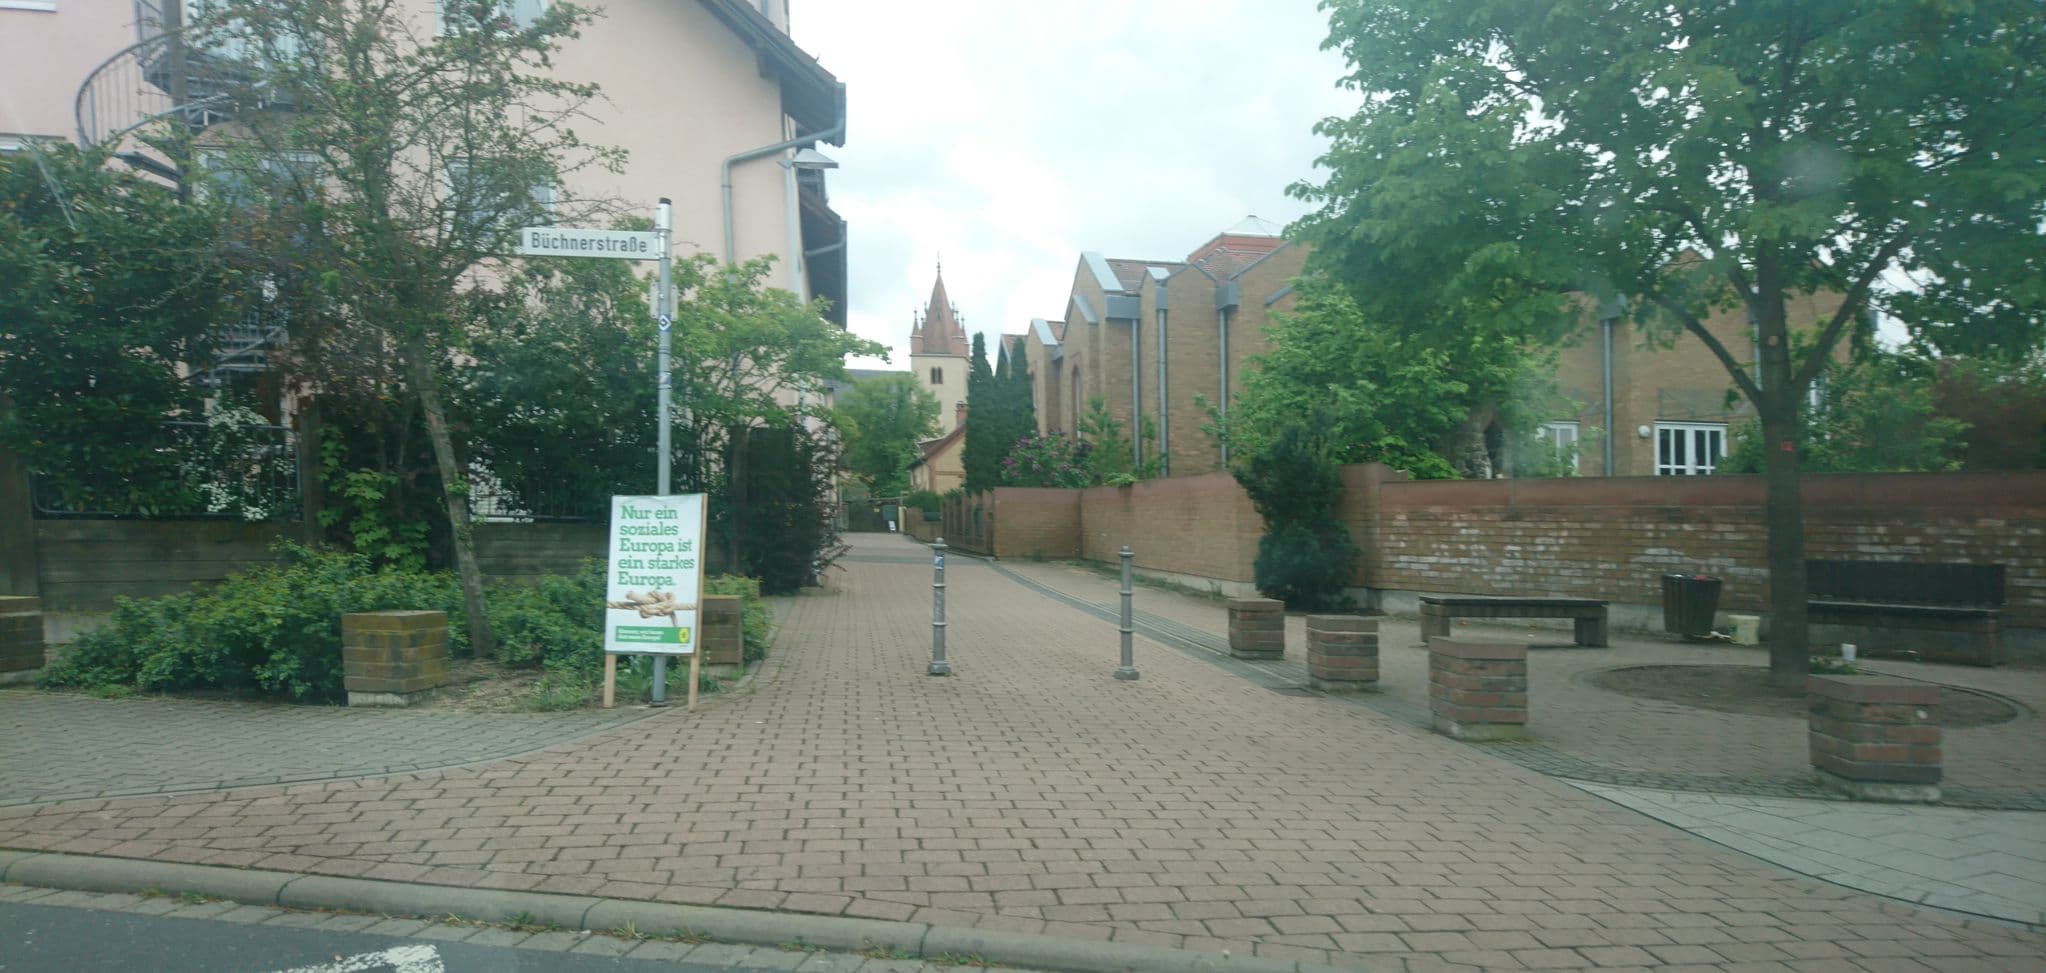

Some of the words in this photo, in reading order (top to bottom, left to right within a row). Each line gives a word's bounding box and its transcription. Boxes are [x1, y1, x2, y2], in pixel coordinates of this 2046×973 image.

[531, 232, 647, 252] Büchnerstraße
[621, 505, 652, 519] Nur
[656, 505, 678, 519] ein
[619, 521, 678, 536] soziales
[619, 537, 674, 556] Europa
[678, 538, 692, 552] ist
[618, 555, 645, 569] ein
[648, 555, 695, 569] starkes
[617, 571, 676, 590] Europa.
